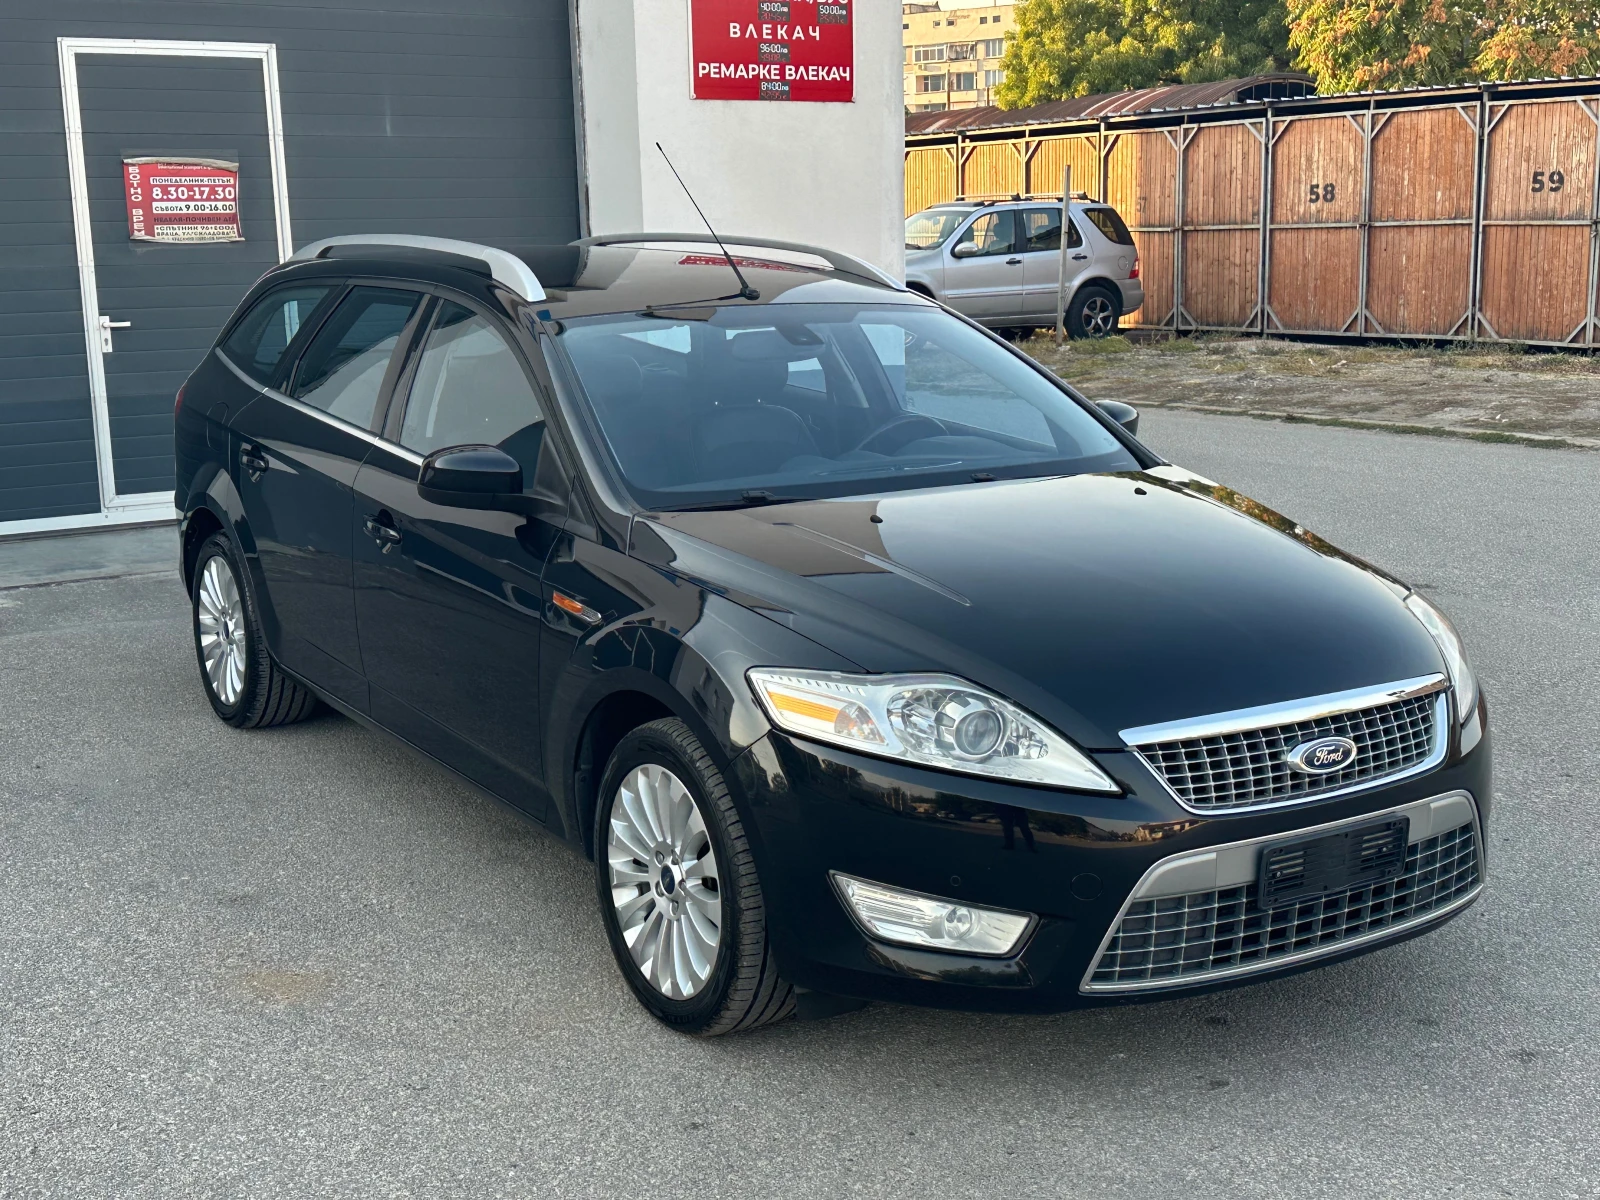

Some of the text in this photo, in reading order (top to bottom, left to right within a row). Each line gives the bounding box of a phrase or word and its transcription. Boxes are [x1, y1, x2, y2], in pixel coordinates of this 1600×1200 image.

[729, 22, 820, 41] ВЛЕКАЧ
[698, 62, 850, 82] РЕМАРКЕ ВЛЕКАЧ
[1530, 170, 1565, 193] 59
[152, 187, 235, 199] 8.30-17.30
[1308, 182, 1336, 204] 58
[184, 204, 234, 212] 9.00-16.00
[1313, 745, 1344, 766] Ford
